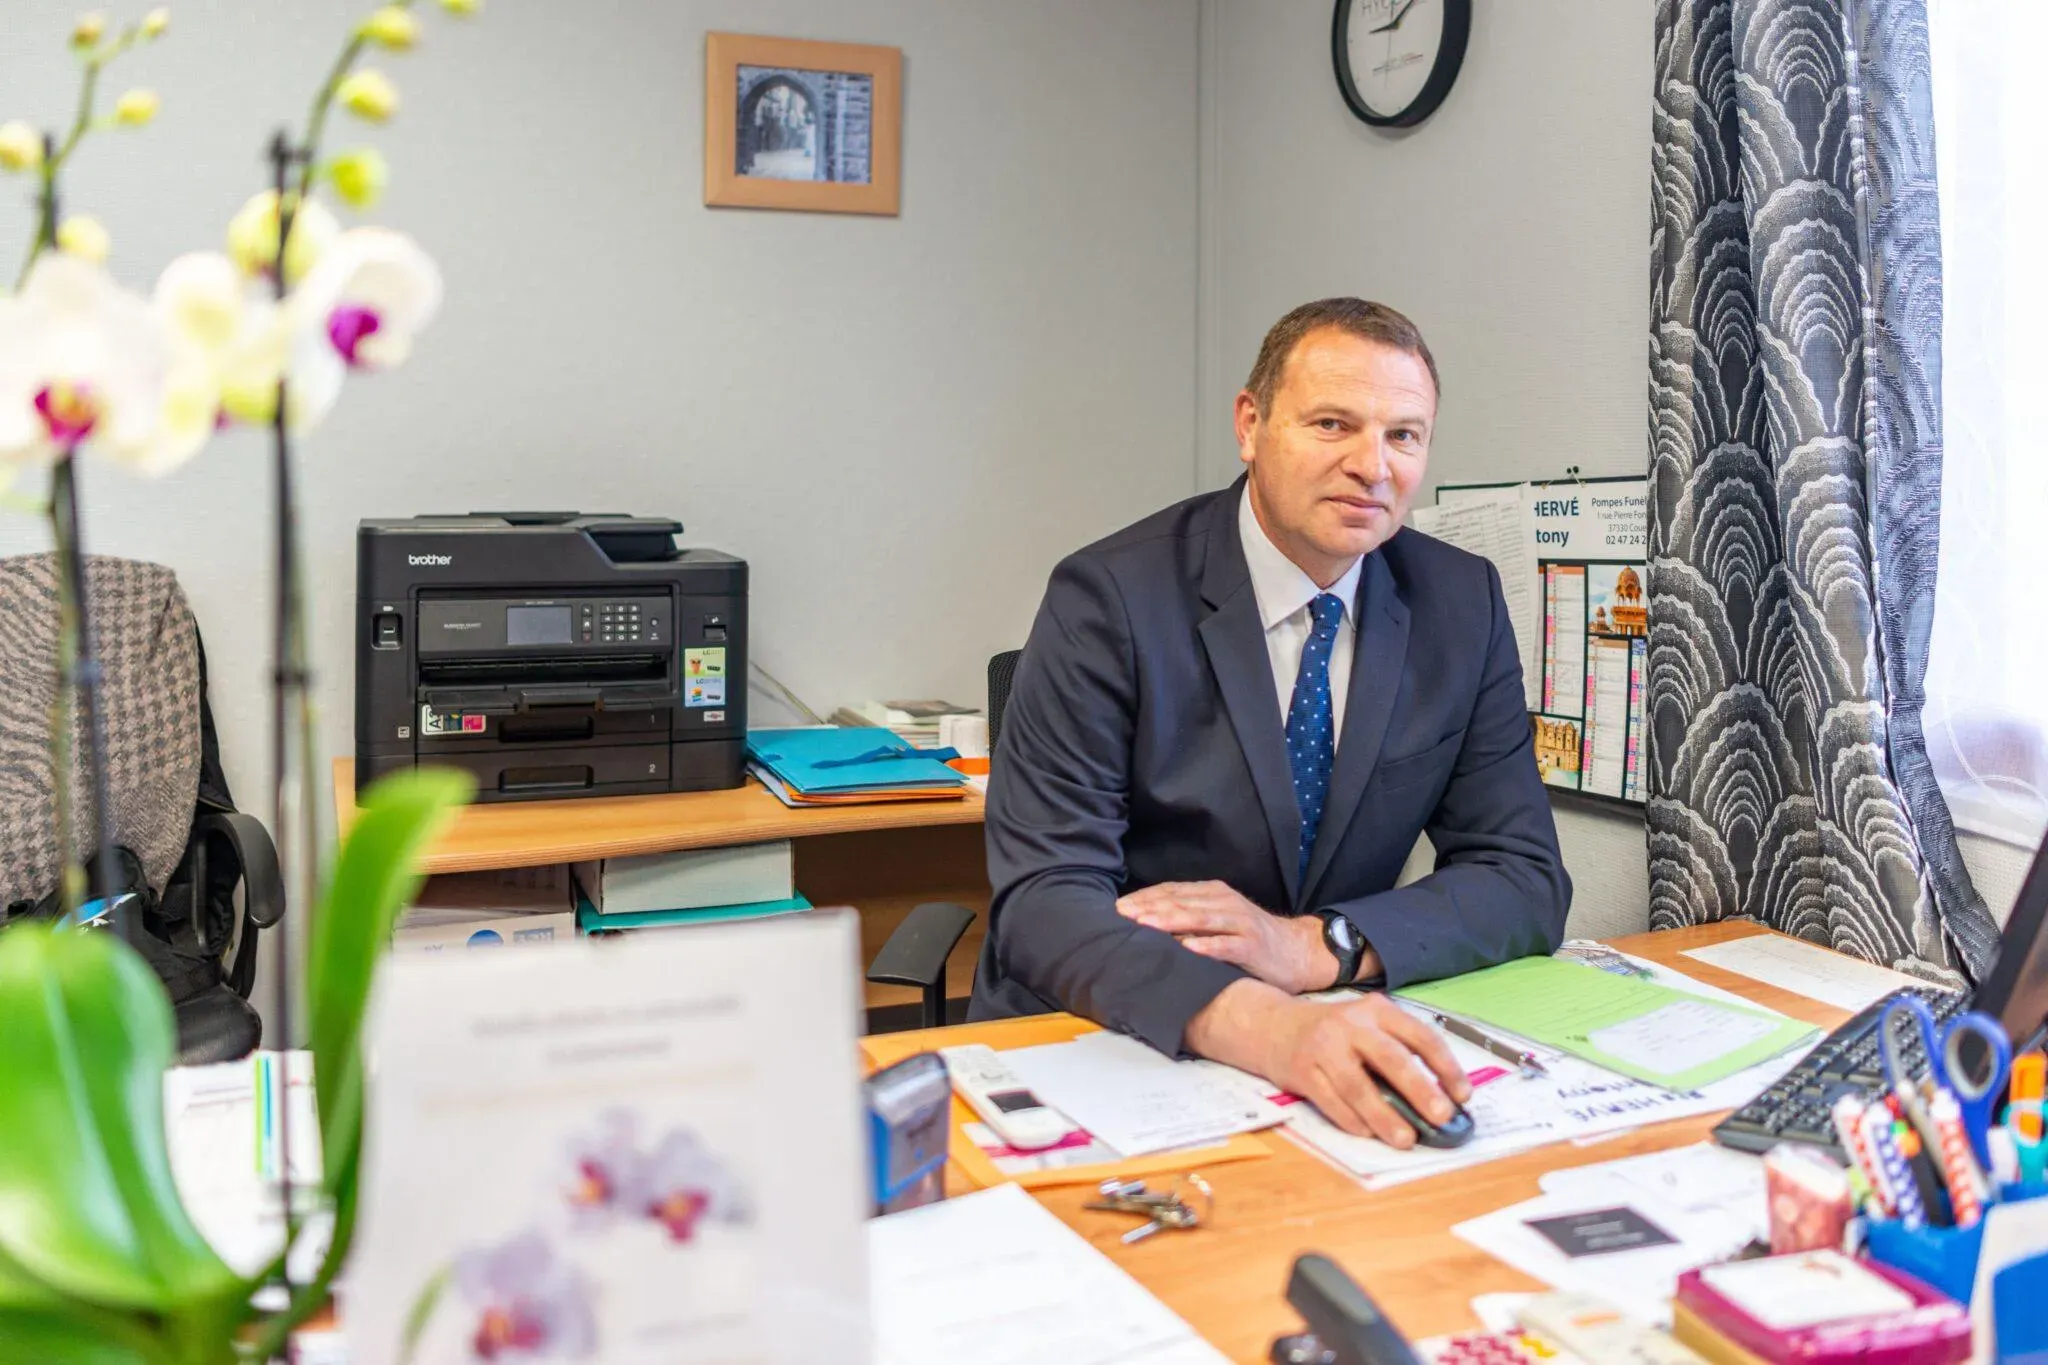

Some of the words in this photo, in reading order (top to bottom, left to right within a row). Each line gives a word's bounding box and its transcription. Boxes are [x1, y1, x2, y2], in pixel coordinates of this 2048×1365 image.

[1591, 498, 1623, 509] Pompes
[1602, 512, 1613, 520] rue
[1614, 511, 1633, 520] Pierre
[1536, 528, 1569, 547] tony
[1605, 535, 1616, 545] 02
[1617, 535, 1628, 545] 47
[1629, 535, 1639, 545] 24
[408, 554, 452, 566] brother
[649, 763, 656, 773] 2
